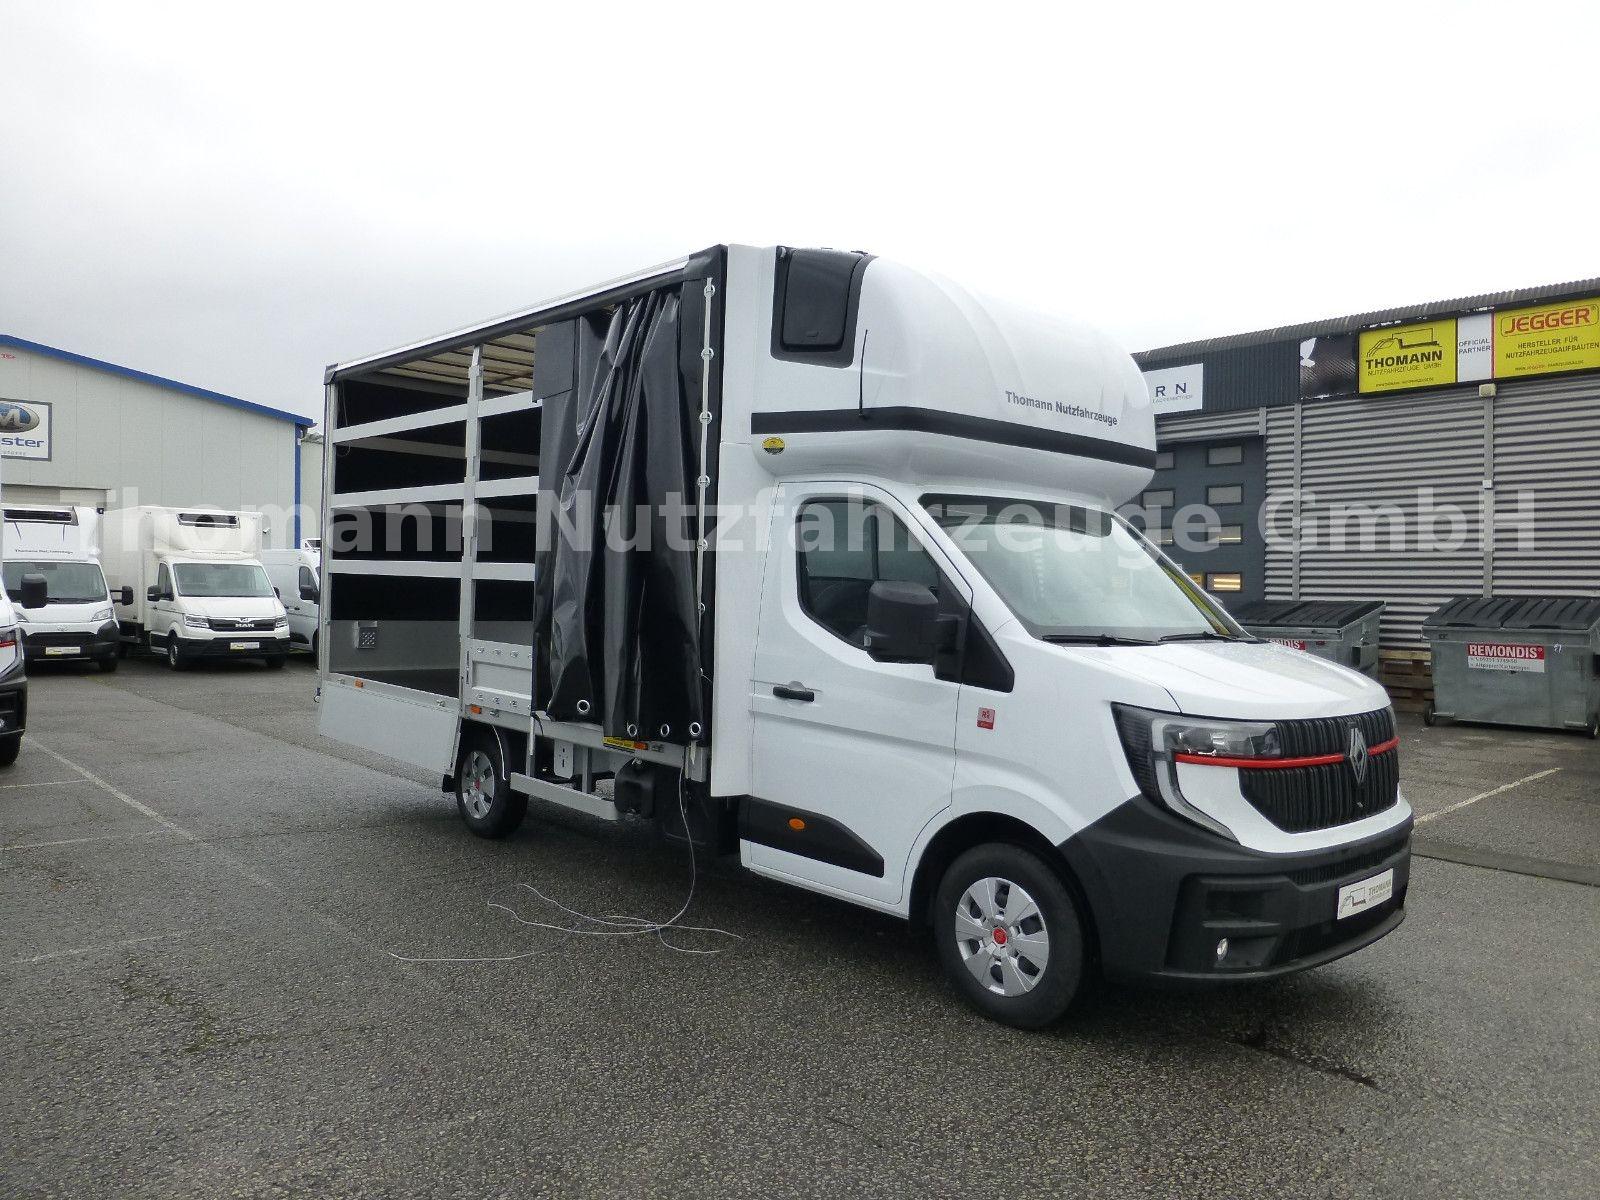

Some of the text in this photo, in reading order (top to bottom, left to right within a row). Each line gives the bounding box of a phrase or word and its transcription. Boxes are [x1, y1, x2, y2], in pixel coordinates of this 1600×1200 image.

[1504, 307, 1591, 335] JEGGER
[1458, 338, 1490, 347] OFFICIAL
[1458, 346, 1491, 355] PARTNER
[1505, 342, 1600, 359] NUTZFAHRZEUGAUFBAUTEN
[1517, 335, 1578, 350] HERSTELLER FÜR
[1365, 350, 1443, 369] THOMANN
[1005, 390, 1118, 426] Thomann Nutzfahrzeuge
[1469, 644, 1538, 659] REMONDIS
